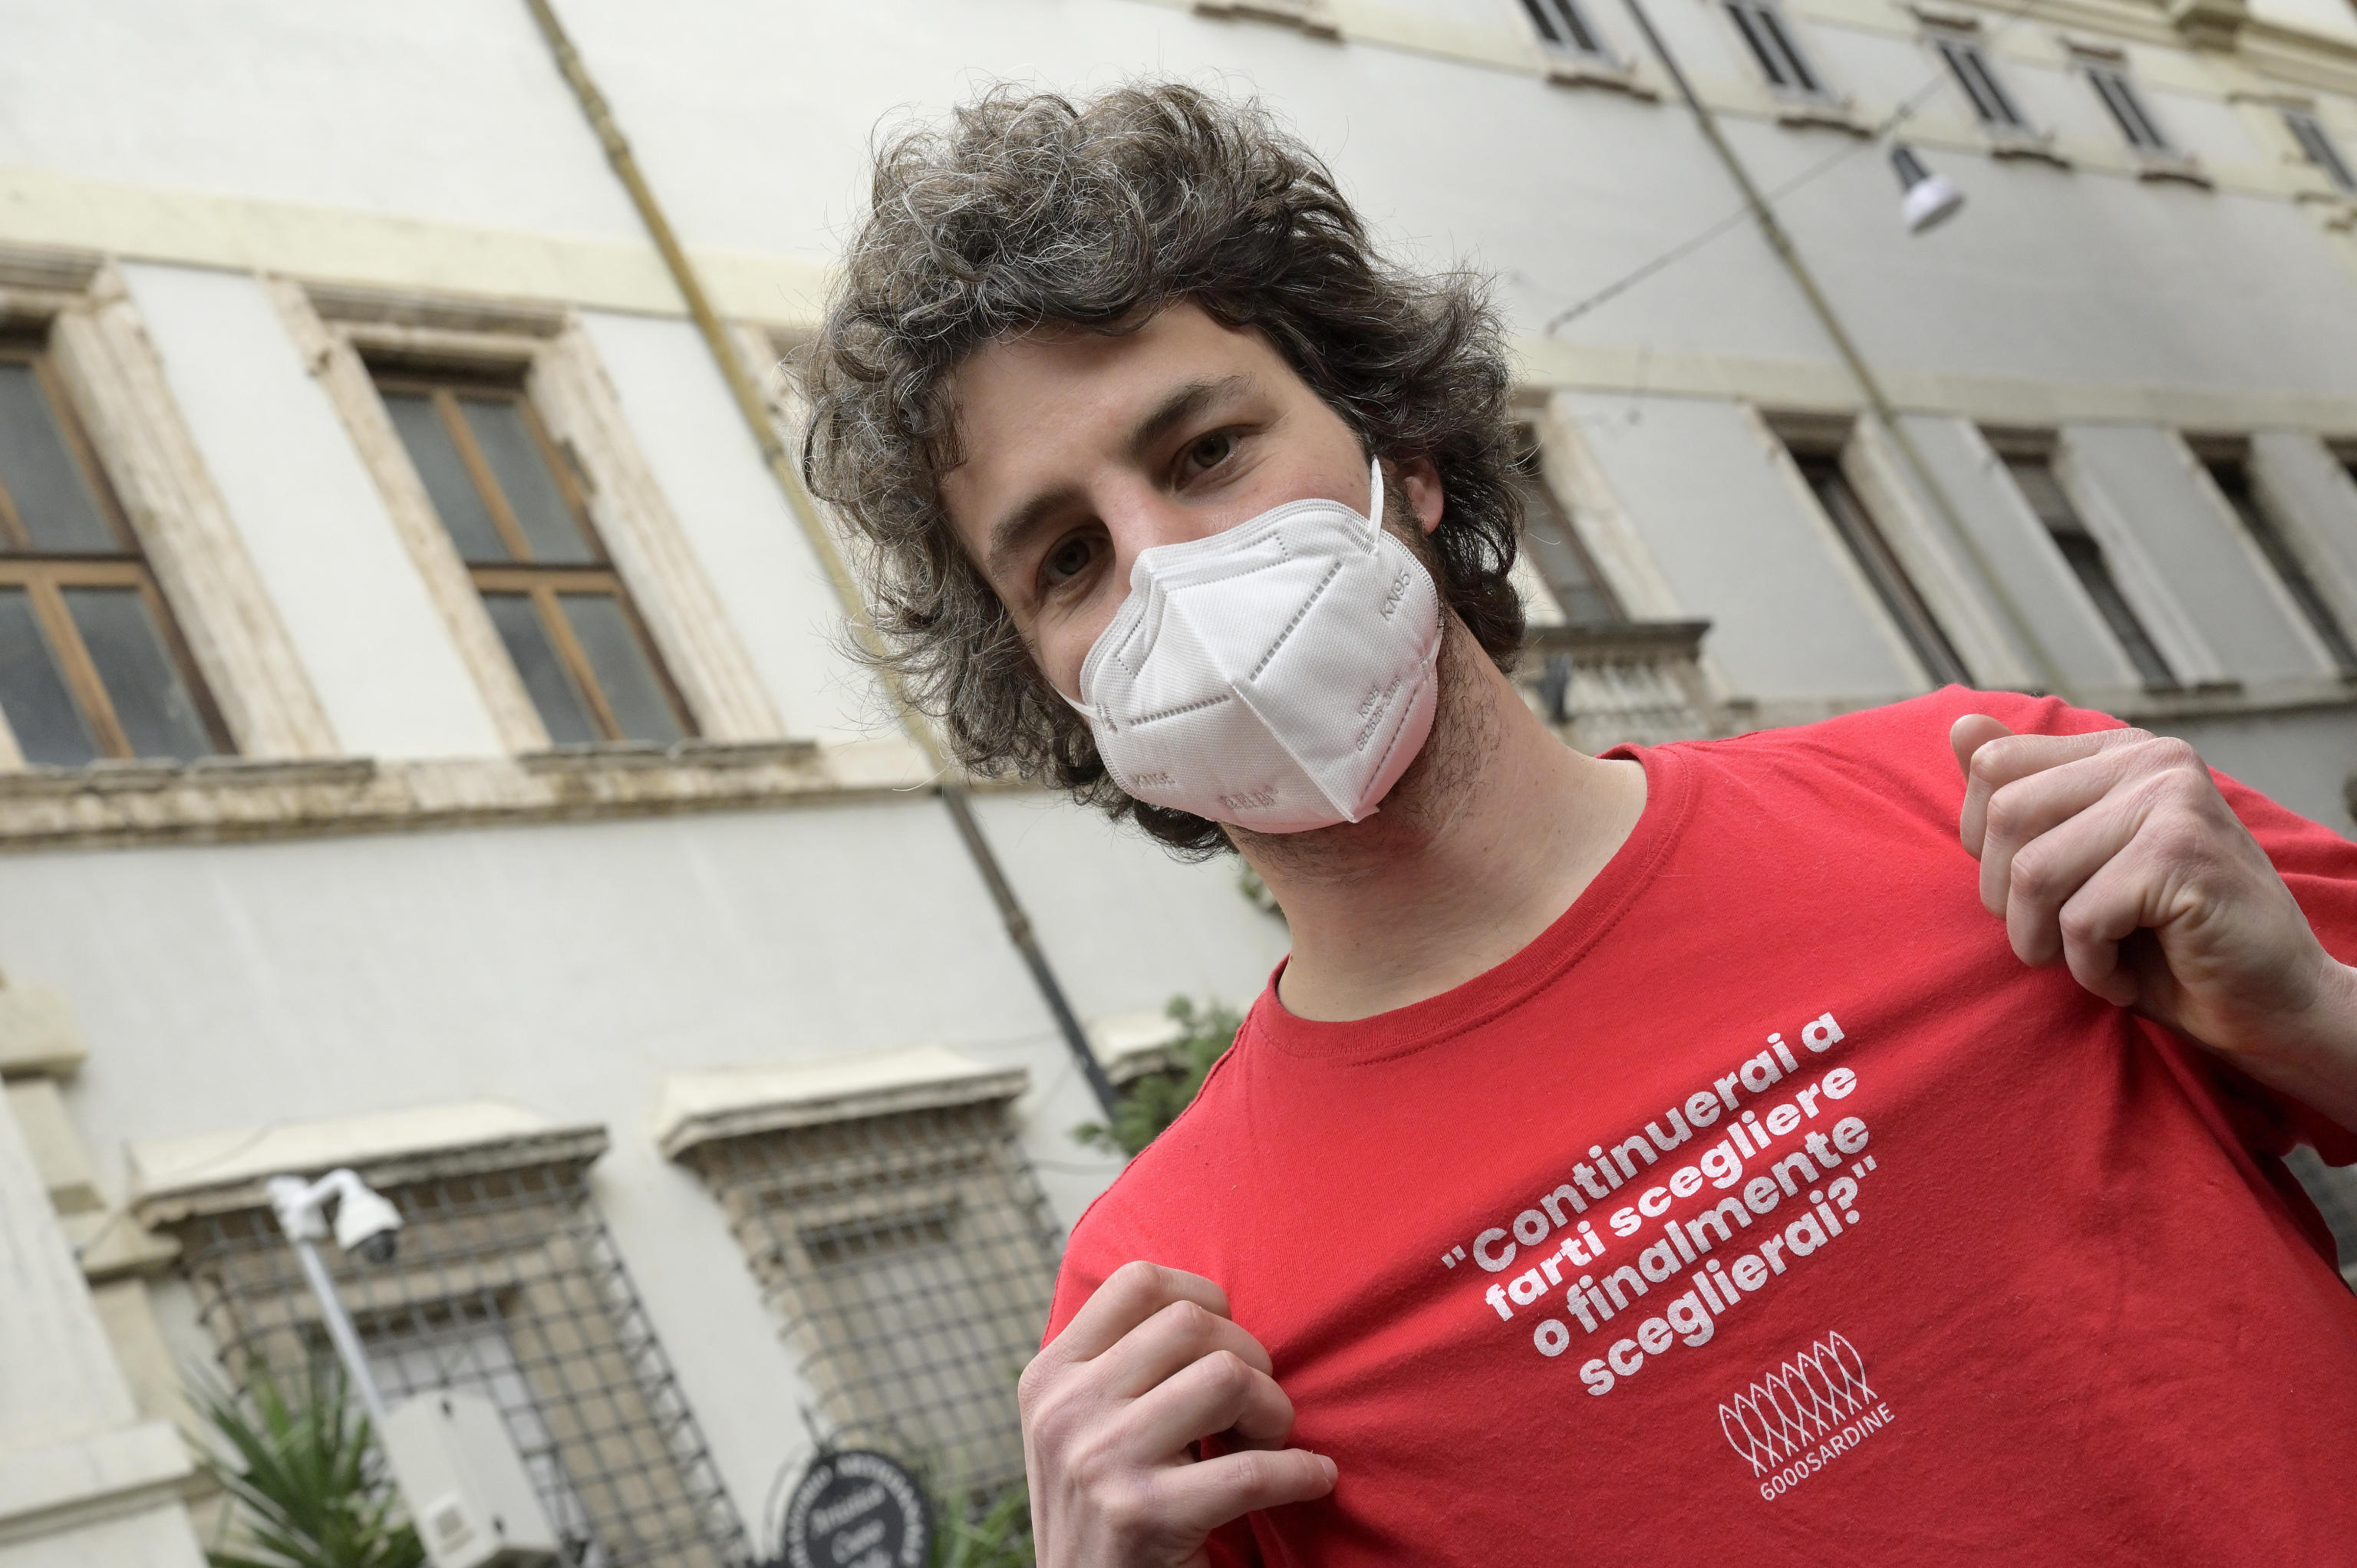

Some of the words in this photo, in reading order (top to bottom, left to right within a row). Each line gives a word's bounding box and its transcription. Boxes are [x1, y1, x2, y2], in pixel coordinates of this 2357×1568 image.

[1380, 568, 1412, 622] KN95
[1441, 1032, 1799, 1273] "Continuerai
[1801, 1011, 1845, 1052] a
[1485, 1220, 1607, 1322] farti
[1609, 1067, 1858, 1237] scegliere
[1533, 1319, 1570, 1357] o
[1566, 1116, 1869, 1333] finalmente
[1579, 1155, 1877, 1396] sceglierai?"
[1760, 1402, 1895, 1501] 6000SARDINE
